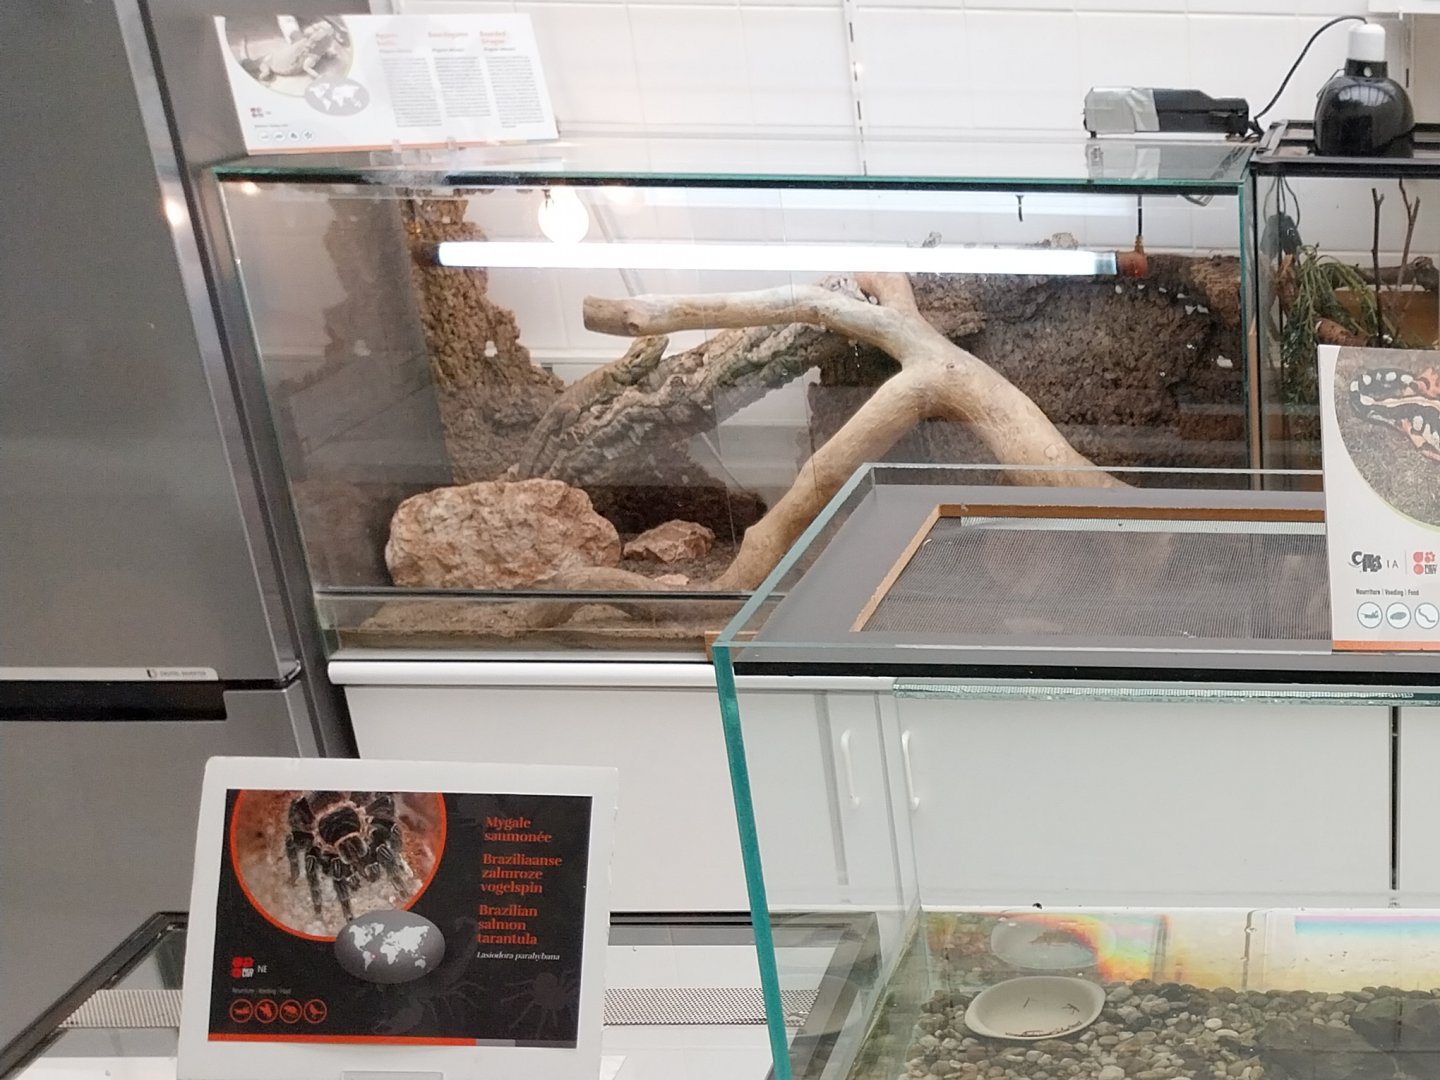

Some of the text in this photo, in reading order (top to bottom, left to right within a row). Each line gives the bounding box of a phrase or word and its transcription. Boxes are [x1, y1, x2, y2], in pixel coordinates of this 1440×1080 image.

[485, 817, 531, 830] Mygale
[484, 831, 552, 842] saumonée
[483, 854, 562, 866] Braziliaanse
[482, 867, 543, 879] zalmroze
[481, 881, 543, 895] vogelspin
[479, 904, 537, 916] Brazilian
[479, 918, 526, 930] salmon
[477, 933, 537, 944] tarantula
[515, 952, 560, 960] parahybana
